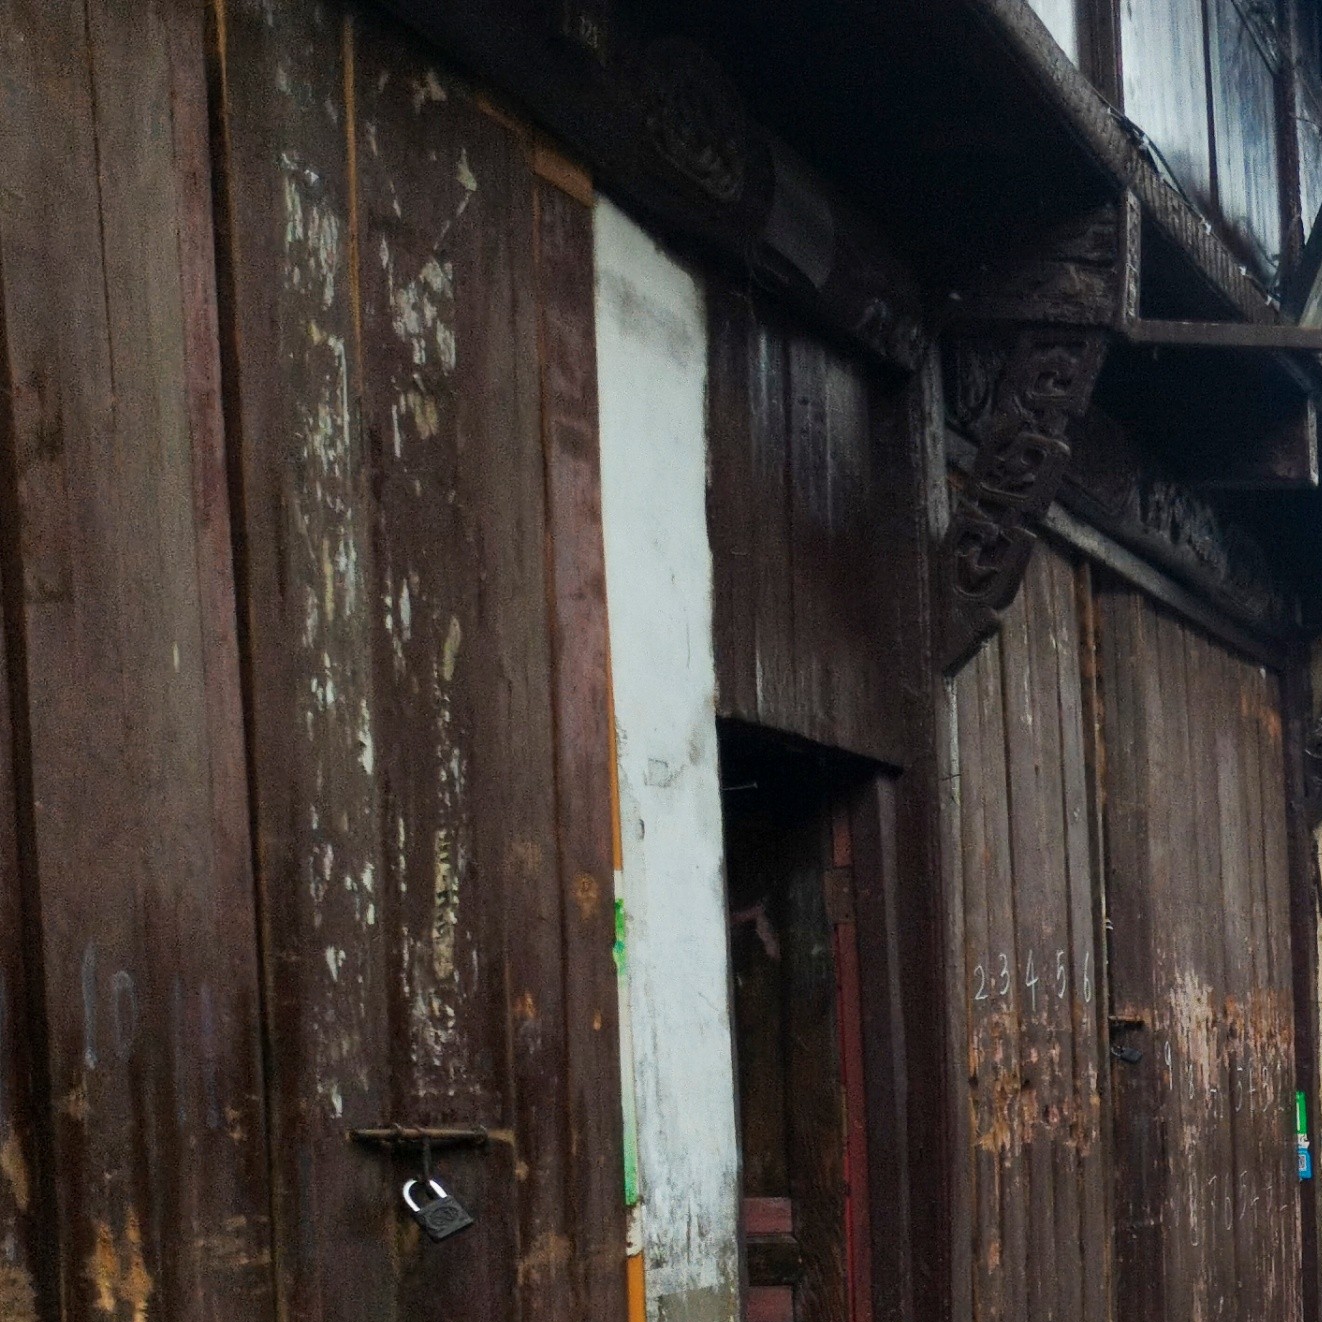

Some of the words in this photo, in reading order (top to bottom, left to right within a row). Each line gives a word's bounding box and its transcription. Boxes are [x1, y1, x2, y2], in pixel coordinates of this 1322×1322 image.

[973, 964, 989, 1000] 2
[998, 952, 1011, 995] 3
[1025, 949, 1039, 1013] 4
[1056, 949, 1067, 999] 5
[1083, 950, 1092, 1003] 6
